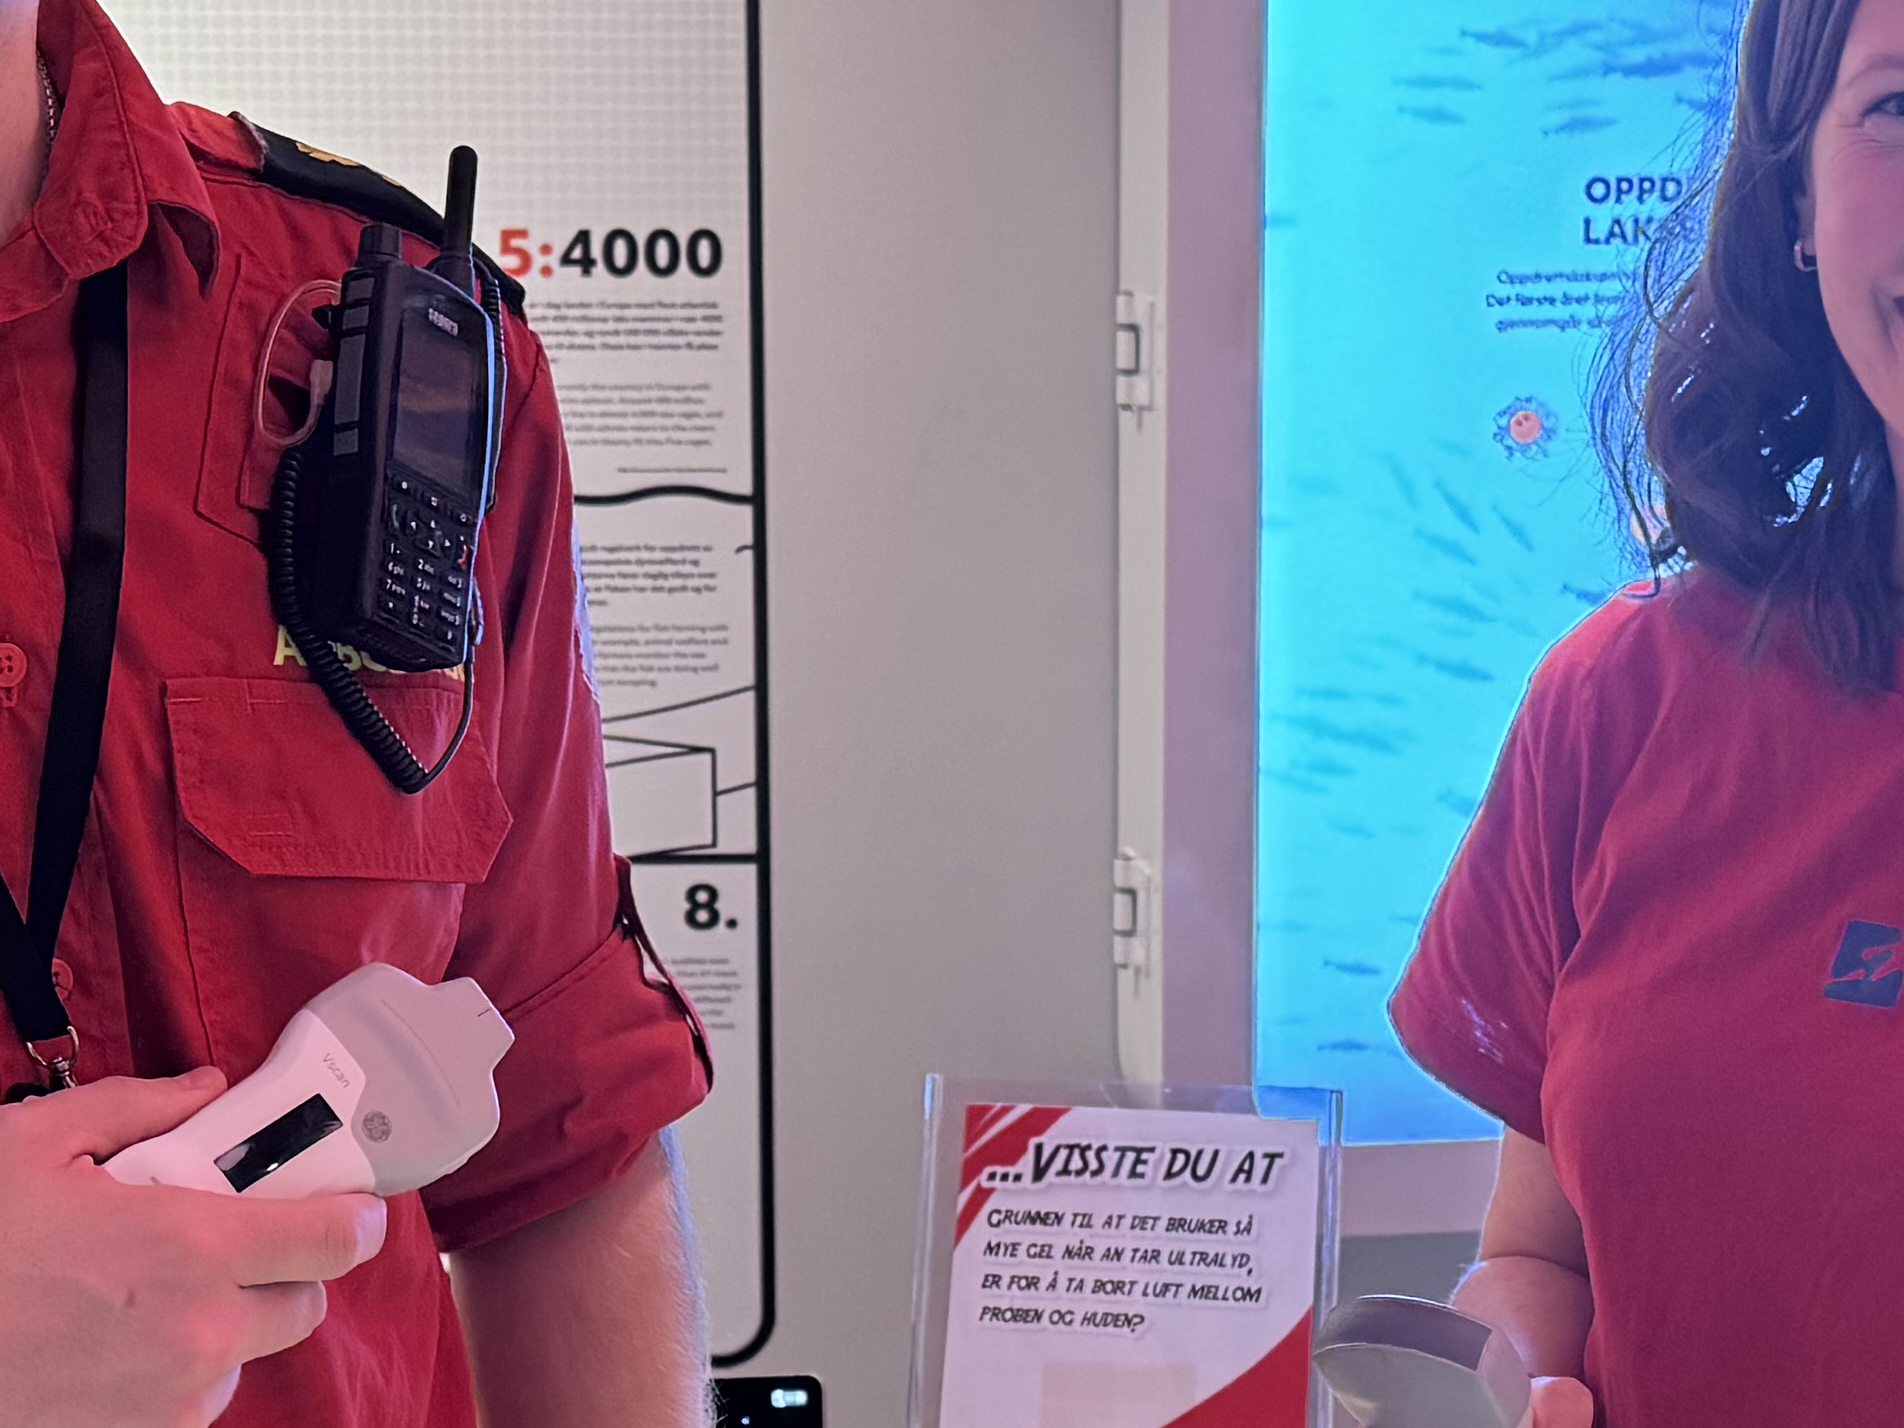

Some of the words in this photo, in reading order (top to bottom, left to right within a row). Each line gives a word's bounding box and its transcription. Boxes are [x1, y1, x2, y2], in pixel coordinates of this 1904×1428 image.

[683, 882, 739, 931] 8.
[320, 1051, 351, 1090] Vscan
[1163, 1147, 1220, 1185] DU
[1229, 1150, 1285, 1186] AT
[986, 1208, 1064, 1230] GRUNNEN
[1070, 1211, 1094, 1230] TIL
[1102, 1213, 1126, 1231] AT
[1130, 1214, 1159, 1232] DET
[1164, 1216, 1228, 1235] BRUKER
[1233, 1214, 1253, 1236] SÅ
[983, 1240, 1019, 1259] MYE
[1026, 1243, 1054, 1261] GEL
[1062, 1239, 1094, 1262] NÅR
[1101, 1246, 1125, 1263] AN
[1129, 1247, 1162, 1265] TAR
[1168, 1250, 1254, 1276] ULTRALYD,
[981, 1273, 1002, 1290] ER
[1007, 1275, 1040, 1292] FOR
[1046, 1271, 1058, 1292] Å
[1065, 1277, 1085, 1293] TA
[1091, 1278, 1137, 1296] BORT
[1142, 1281, 1183, 1300] LUFT
[1187, 1284, 1262, 1304] MELLOM
[979, 1306, 1043, 1324] PROBEN
[1048, 1309, 1074, 1327] OG
[1080, 1311, 1146, 1333] HUDEN?
